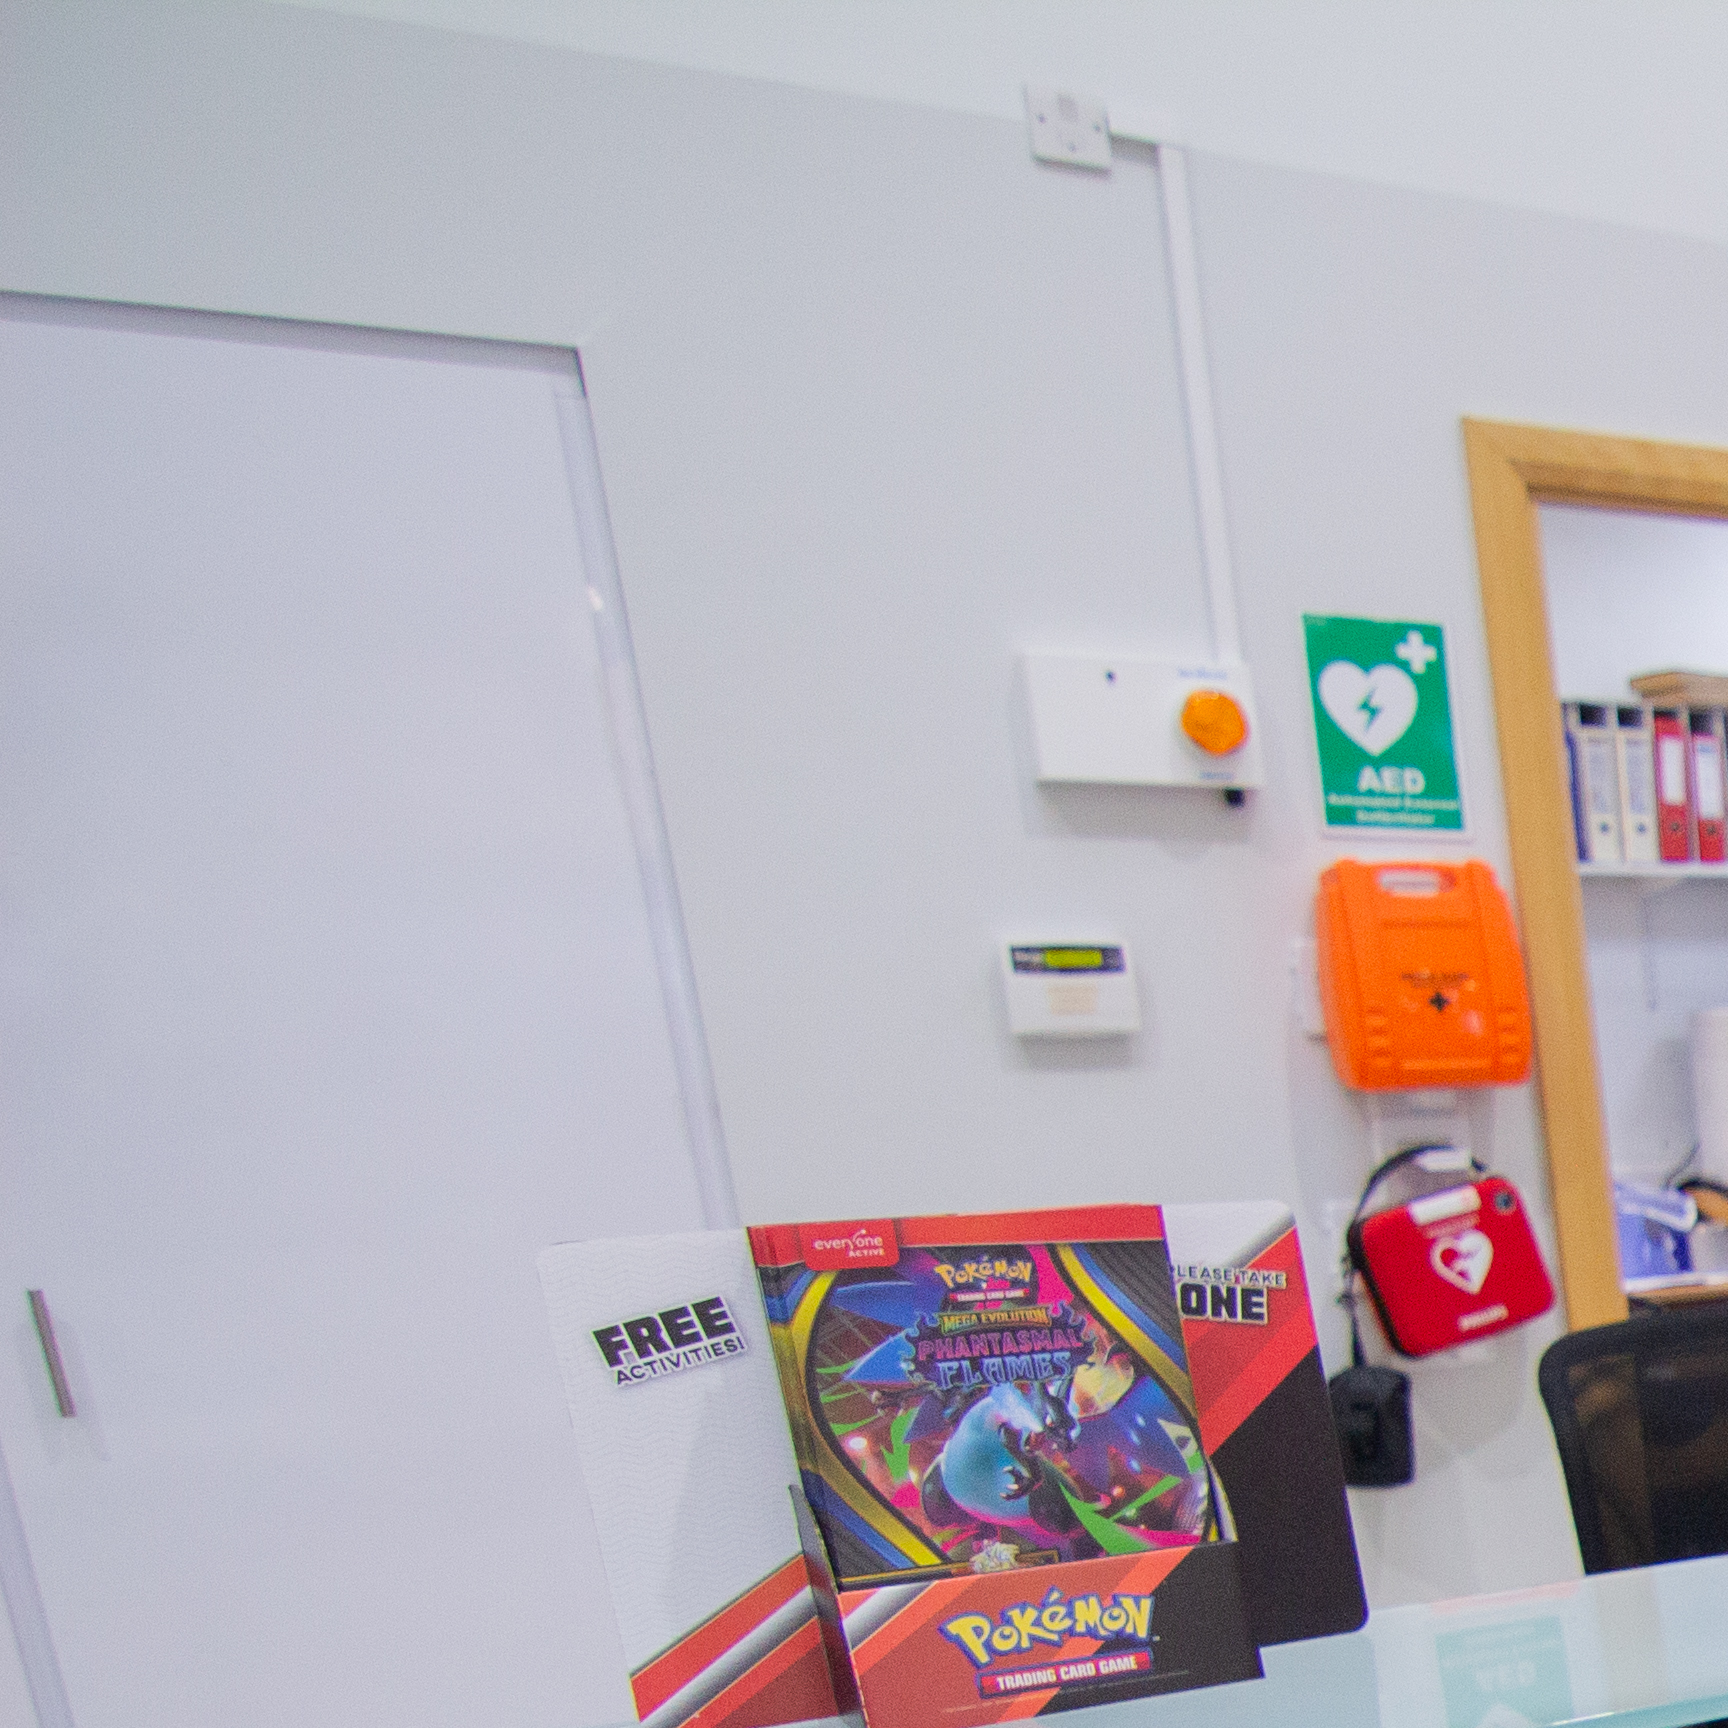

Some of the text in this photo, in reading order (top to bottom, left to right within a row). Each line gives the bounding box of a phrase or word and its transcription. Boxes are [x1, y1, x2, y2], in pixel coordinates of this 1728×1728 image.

[1358, 766, 1426, 795] AED
[814, 1229, 884, 1251] everyone
[848, 1247, 885, 1257] ACTIVE
[1239, 1270, 1284, 1286] TAKE
[1180, 1283, 1265, 1321] ONE
[592, 1296, 737, 1368] FREE
[942, 1308, 1049, 1332] MEGA EVOLUTION
[616, 1336, 745, 1385] ACTIVITIES!
[917, 1328, 1083, 1361] PHANTASMAL
[936, 1350, 1071, 1390] FLAMES
[997, 1670, 1056, 1691] TRADING
[1059, 1662, 1096, 1682] CARD
[1099, 1654, 1138, 1674] GAME
